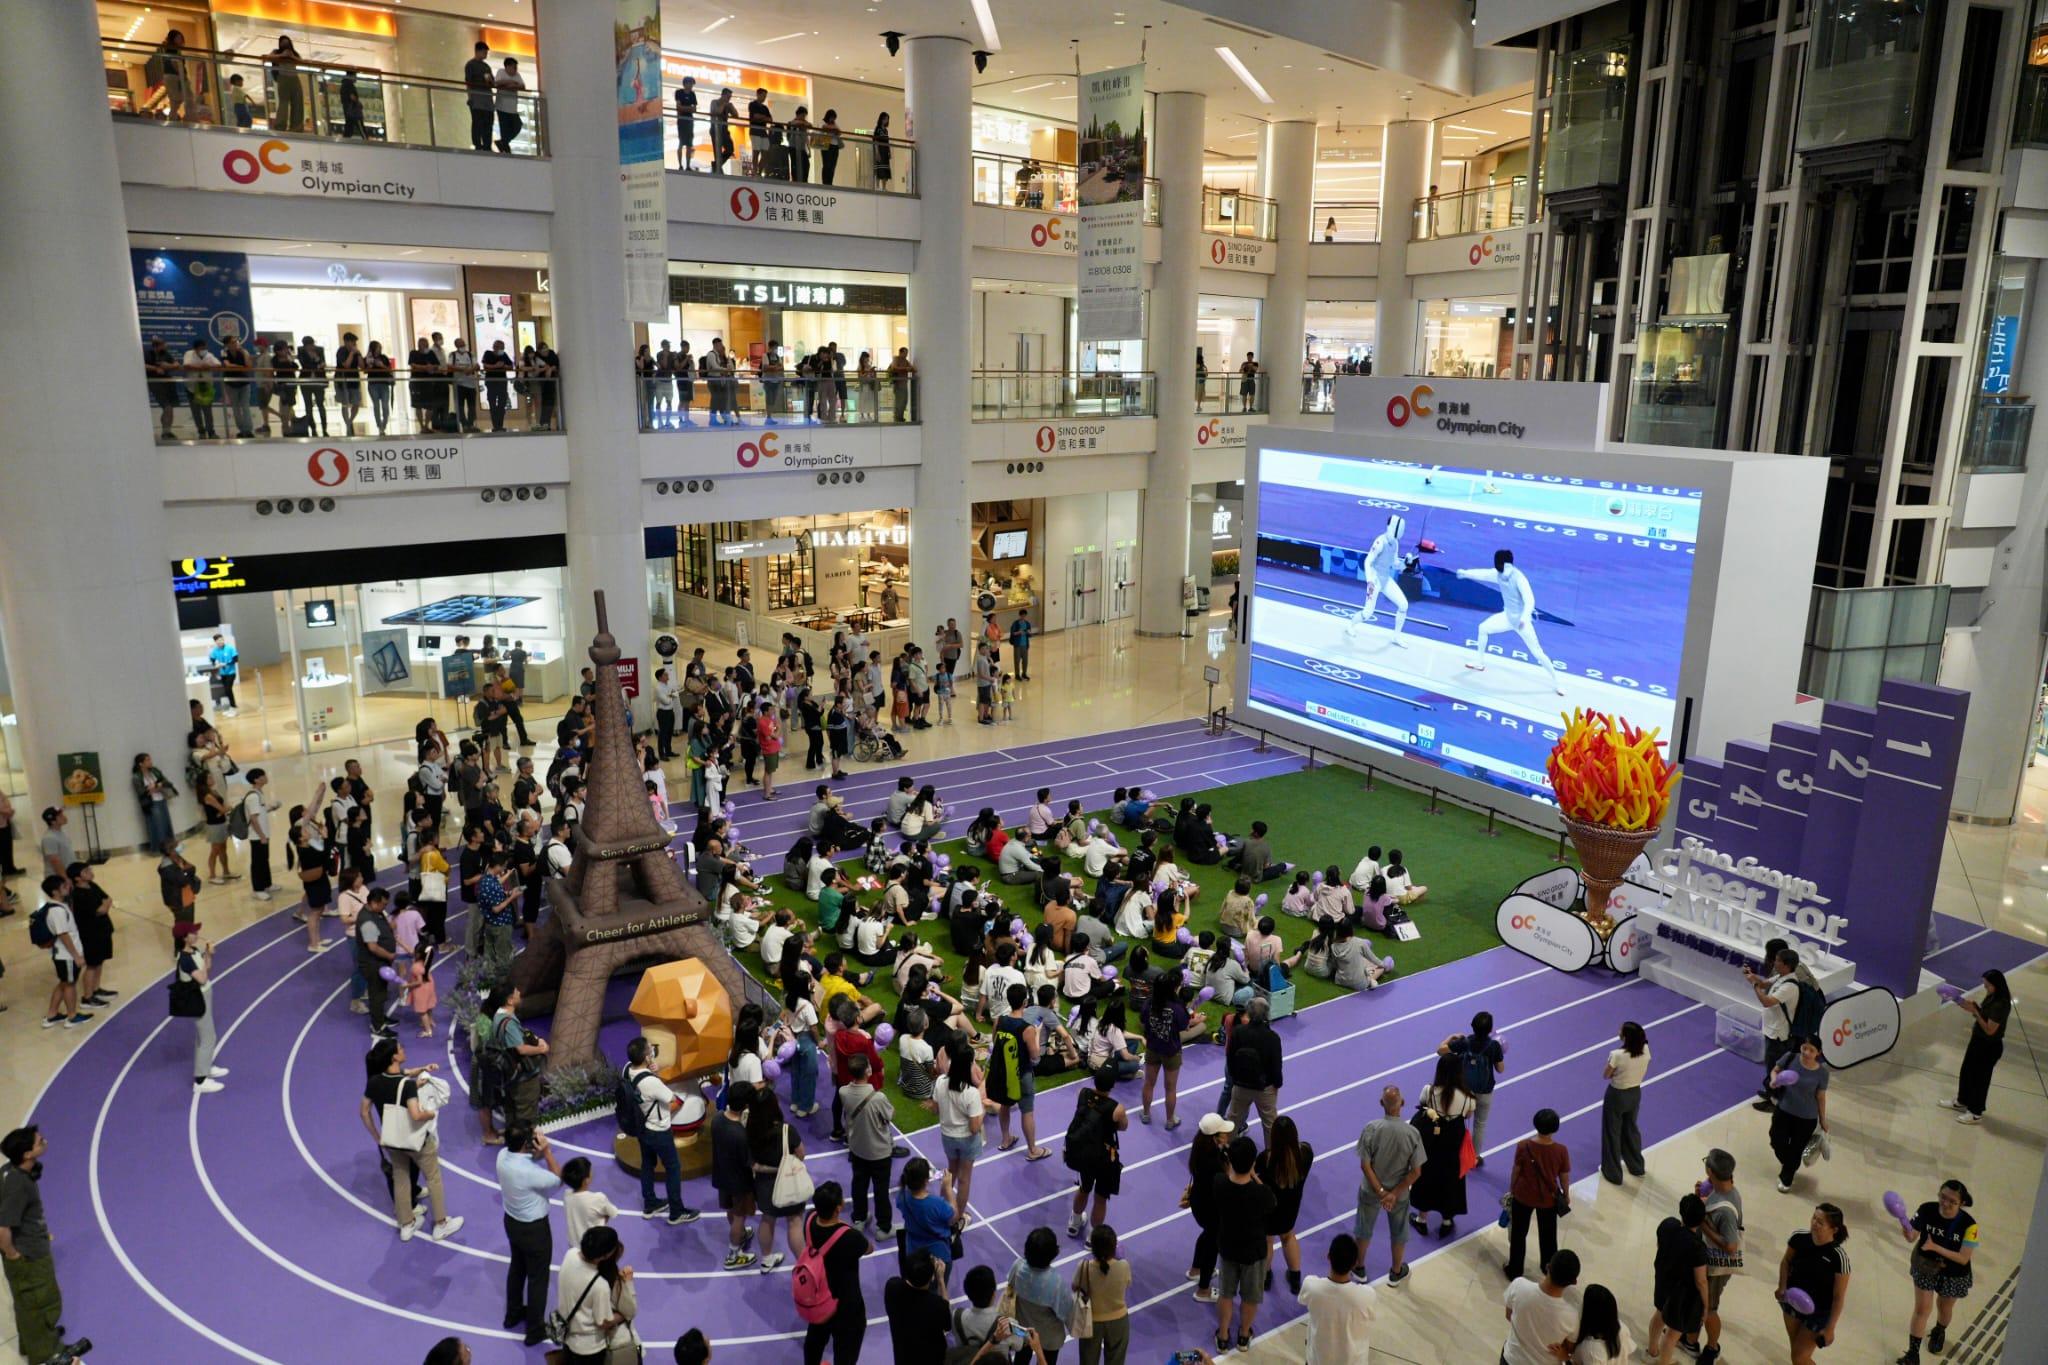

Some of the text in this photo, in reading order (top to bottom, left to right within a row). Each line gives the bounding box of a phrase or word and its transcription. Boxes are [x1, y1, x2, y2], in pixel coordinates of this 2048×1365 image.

[223, 139, 293, 184] OC
[302, 176, 415, 199] Olympian City
[764, 191, 837, 208] SINO GROUP
[765, 206, 824, 225] 信和集團
[1031, 217, 1061, 247] OC
[1469, 235, 1493, 265] OC
[734, 284, 786, 303] TSL
[1387, 384, 1434, 428] OC
[1057, 425, 1106, 436] SINO GROUP
[1197, 418, 1219, 445] OC
[1436, 417, 1526, 439] Olympian City
[355, 447, 458, 462] SINO GROUP
[737, 432, 779, 468] OC
[1058, 437, 1097, 451] 信和集團
[784, 454, 854, 468] Olympian City
[357, 464, 441, 483] 信和集團
[616, 664, 634, 672] MUJI
[1452, 702, 1559, 741] PARIS
[1885, 738, 1932, 758] 1
[1828, 749, 1869, 779] 2
[1776, 768, 1814, 796] 3
[1730, 784, 1763, 809] 4
[1688, 798, 1718, 822] 5
[601, 842, 660, 859] Sino Group
[1681, 836, 1818, 902] Sino Group
[1550, 881, 1569, 895] GROUP
[1653, 848, 1849, 941] Cheer For
[586, 912, 698, 942] Cheer for Athletes
[1511, 914, 1536, 930] OC
[1533, 932, 1574, 957] Olympian City
[1833, 1018, 1852, 1047] OC
[1926, 1223, 1961, 1242] PIXR
